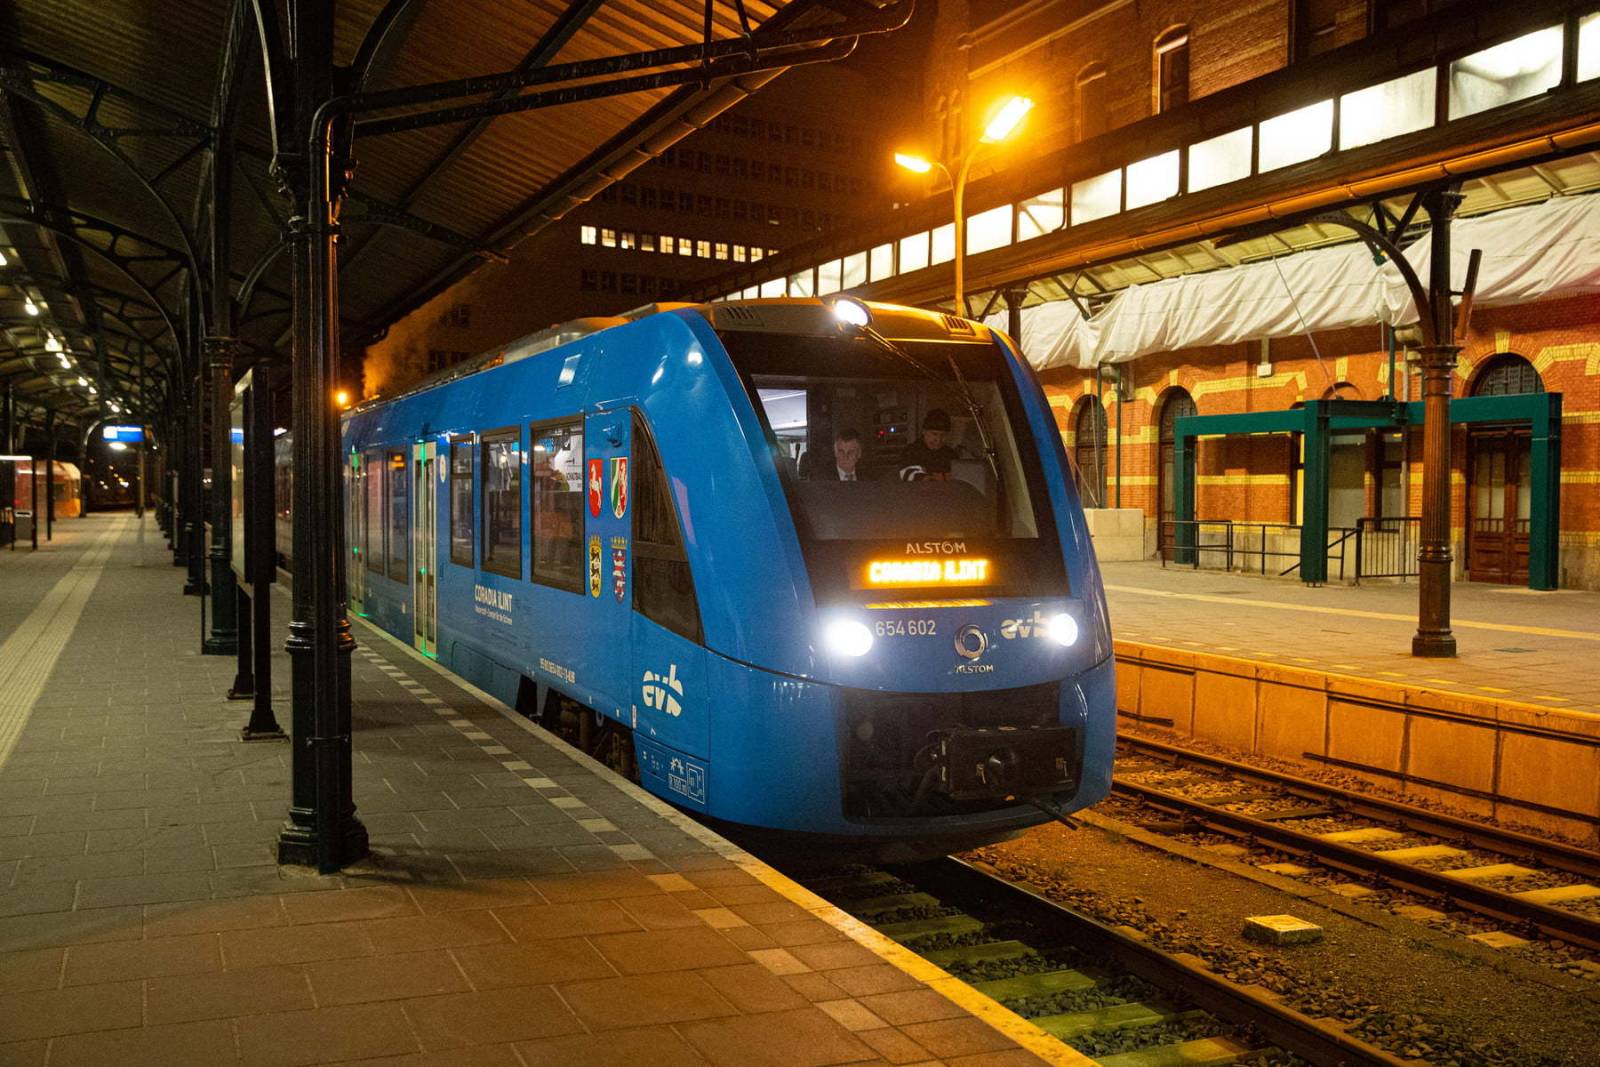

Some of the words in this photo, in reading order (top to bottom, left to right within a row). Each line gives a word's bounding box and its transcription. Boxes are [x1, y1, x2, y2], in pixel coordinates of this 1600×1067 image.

[905, 541, 968, 555] ALSTOM
[875, 620, 905, 637] 654
[908, 619, 937, 636] 602
[955, 664, 994, 674] ALSTOM
[642, 663, 684, 718] evb
